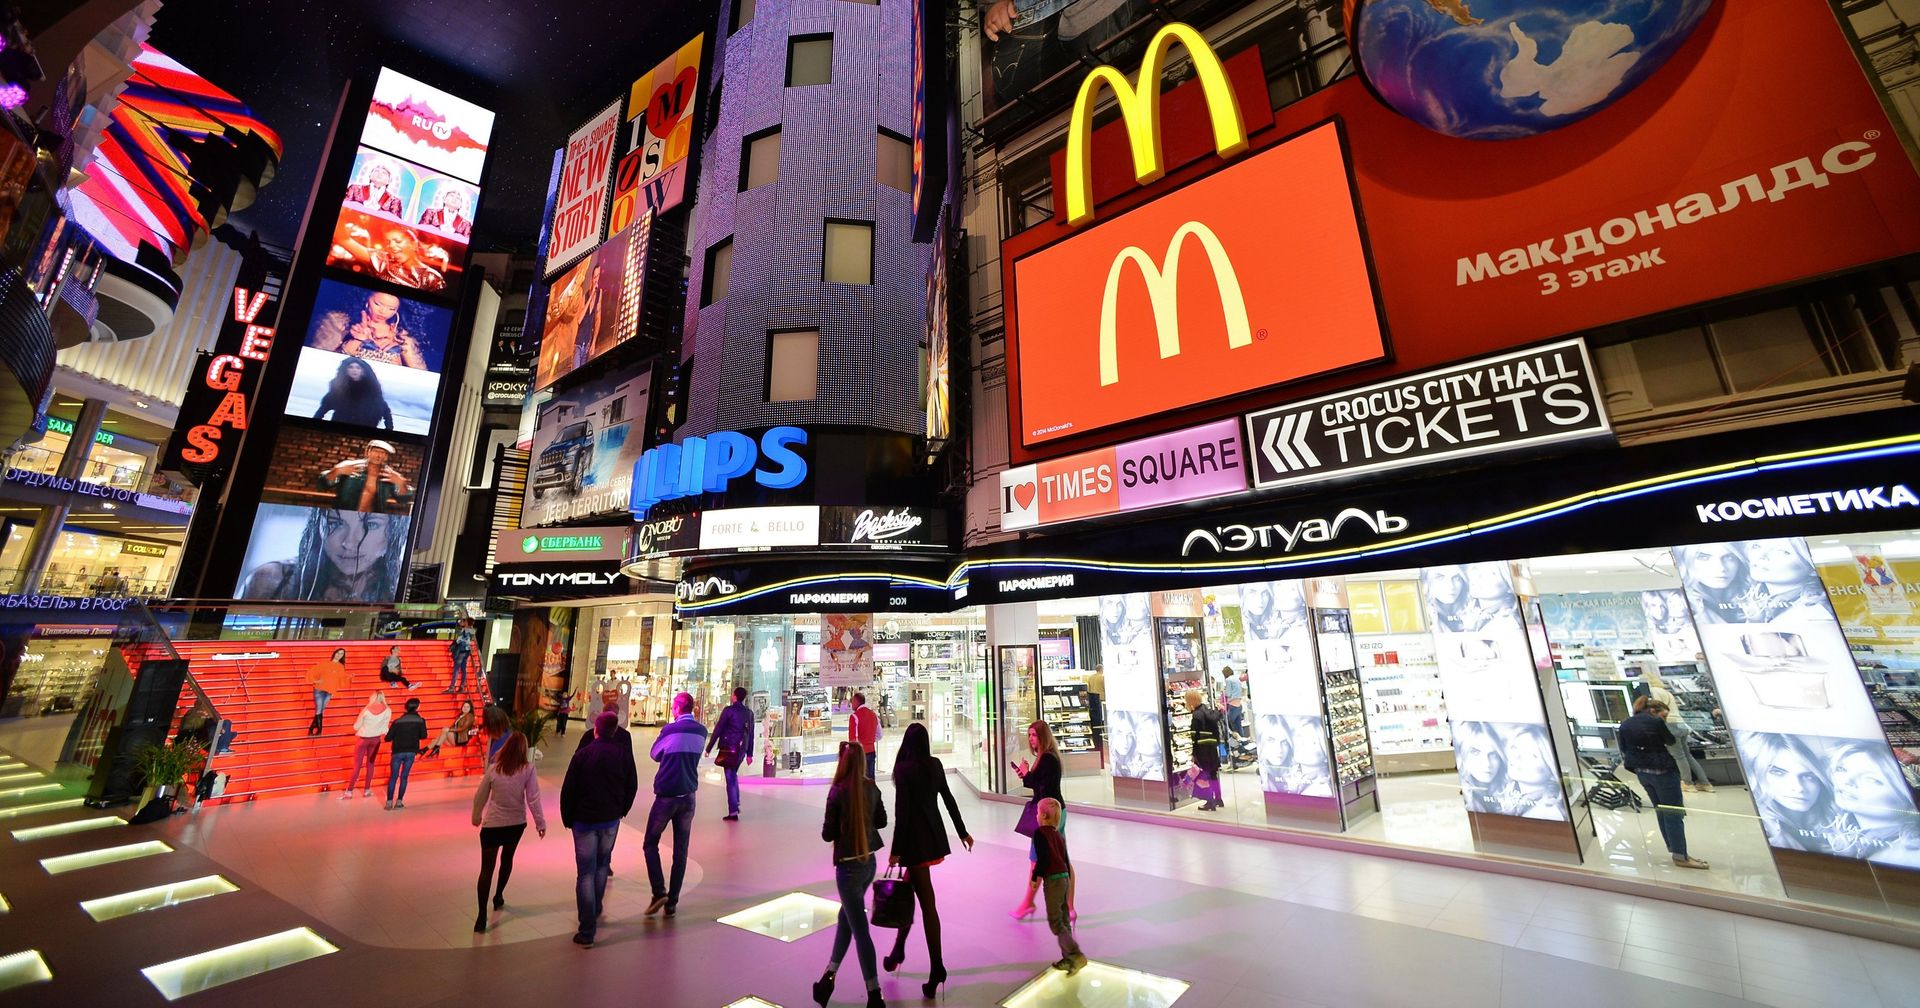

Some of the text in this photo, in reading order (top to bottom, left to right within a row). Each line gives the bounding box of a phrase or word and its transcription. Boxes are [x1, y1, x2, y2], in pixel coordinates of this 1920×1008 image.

[411, 115, 448, 135] RU TV
[569, 113, 617, 162] TIMES SQUARE
[559, 133, 614, 209] NEW
[550, 186, 605, 260] STORY
[1538, 247, 1666, 296] 3 этаж
[181, 287, 276, 463] VEGAS
[1320, 353, 1579, 427] CROCUS CITY HALL
[1324, 383, 1590, 464] TICKETS
[1002, 437, 1239, 515] I TIMES SQUARE
[543, 501, 569, 523] JEEP
[1696, 484, 1920, 523] КОСМЕТИКА
[541, 535, 602, 549] СБЕРБАНК
[712, 523, 743, 535] FORTE
[768, 520, 805, 532] BELLO
[851, 506, 923, 544] Backstage
[498, 572, 621, 586] TONYMOLY
[999, 574, 1074, 593] ПАРФЮМЕРИЯ
[0, 594, 76, 610] «БАЗЕЛЬ»
[80, 598, 90, 610] В
[790, 593, 869, 604] ПАРФЮМЕРИЯ
[873, 632, 901, 640] REVLON
